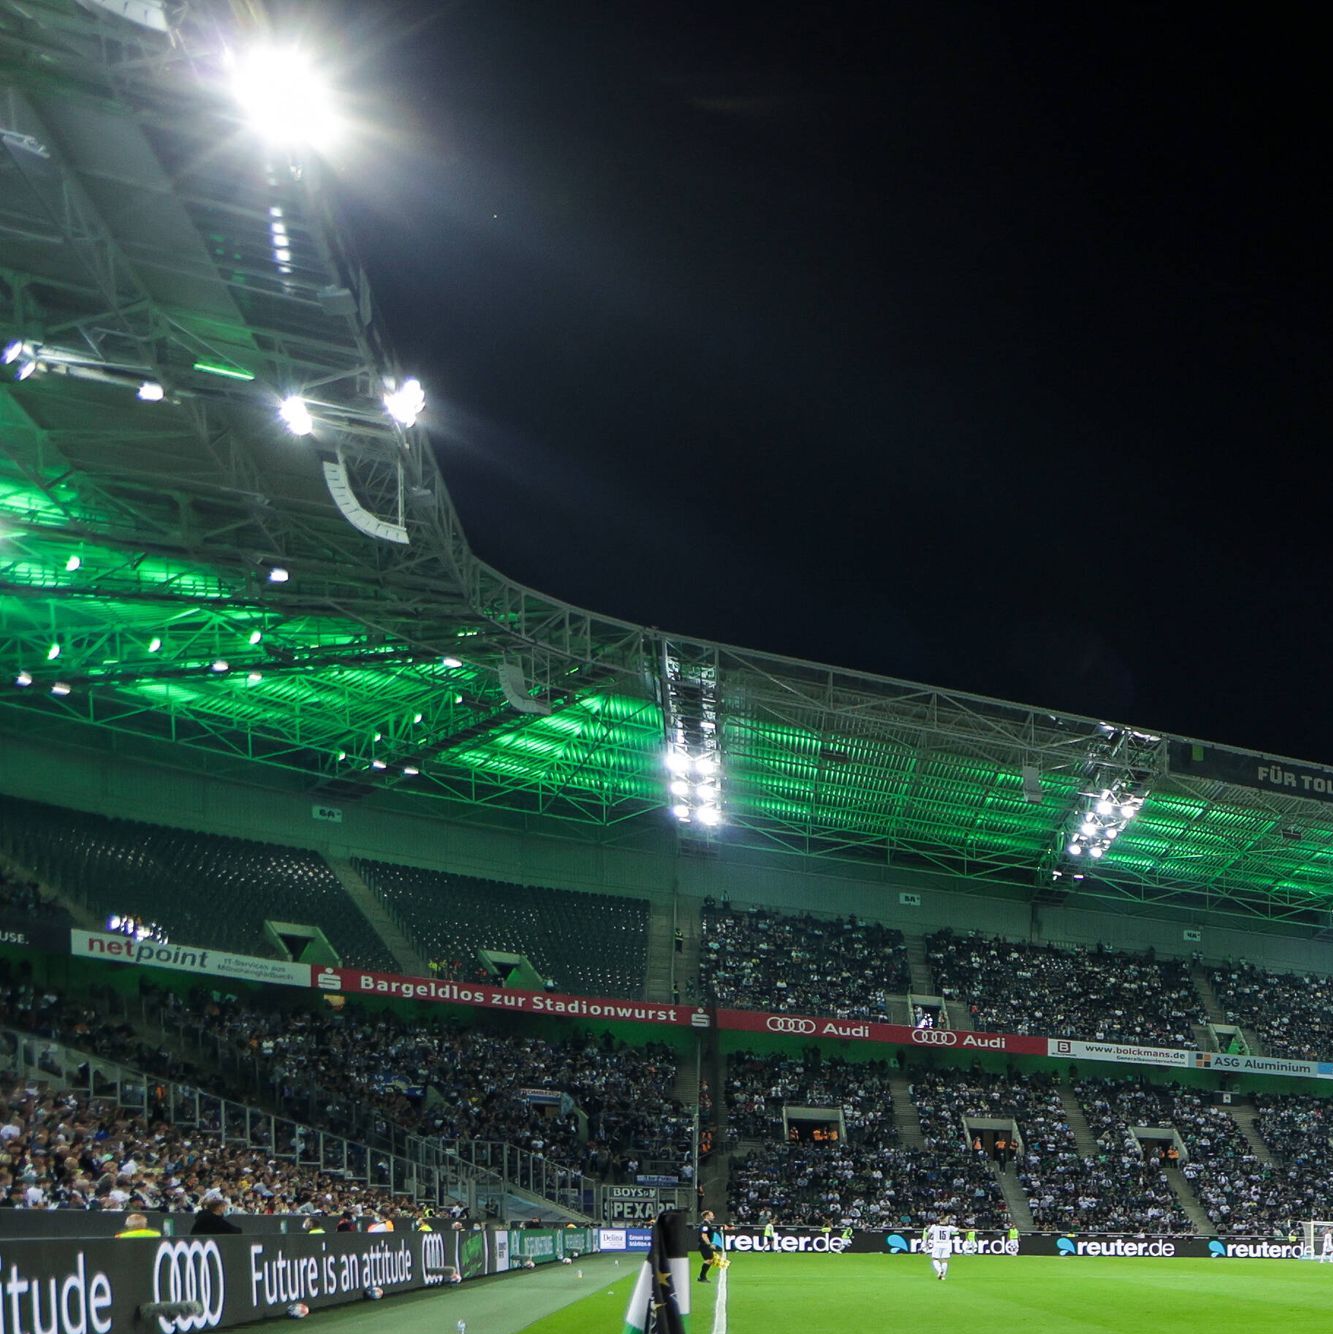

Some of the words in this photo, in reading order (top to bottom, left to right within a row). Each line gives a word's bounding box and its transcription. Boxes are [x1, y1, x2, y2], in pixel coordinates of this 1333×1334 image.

[1257, 765, 1297, 789] FÜR
[88, 935, 209, 968] netpoint
[360, 975, 485, 1003] Bargeldlos
[491, 993, 526, 1009] zur
[532, 996, 677, 1022] Stadionwurst
[822, 1023, 870, 1038] Audi
[963, 1034, 1006, 1049] Audi
[1085, 1044, 1186, 1060] www.bolckmans.de
[1214, 1056, 1240, 1068] ASG
[1244, 1059, 1311, 1073] Aluminium
[613, 1187, 643, 1197] BOYS
[1077, 1238, 1175, 1257] reuter.de
[250, 1244, 319, 1307] Future
[321, 1241, 337, 1295] is
[340, 1257, 359, 1291] an
[362, 1239, 412, 1288] attitude
